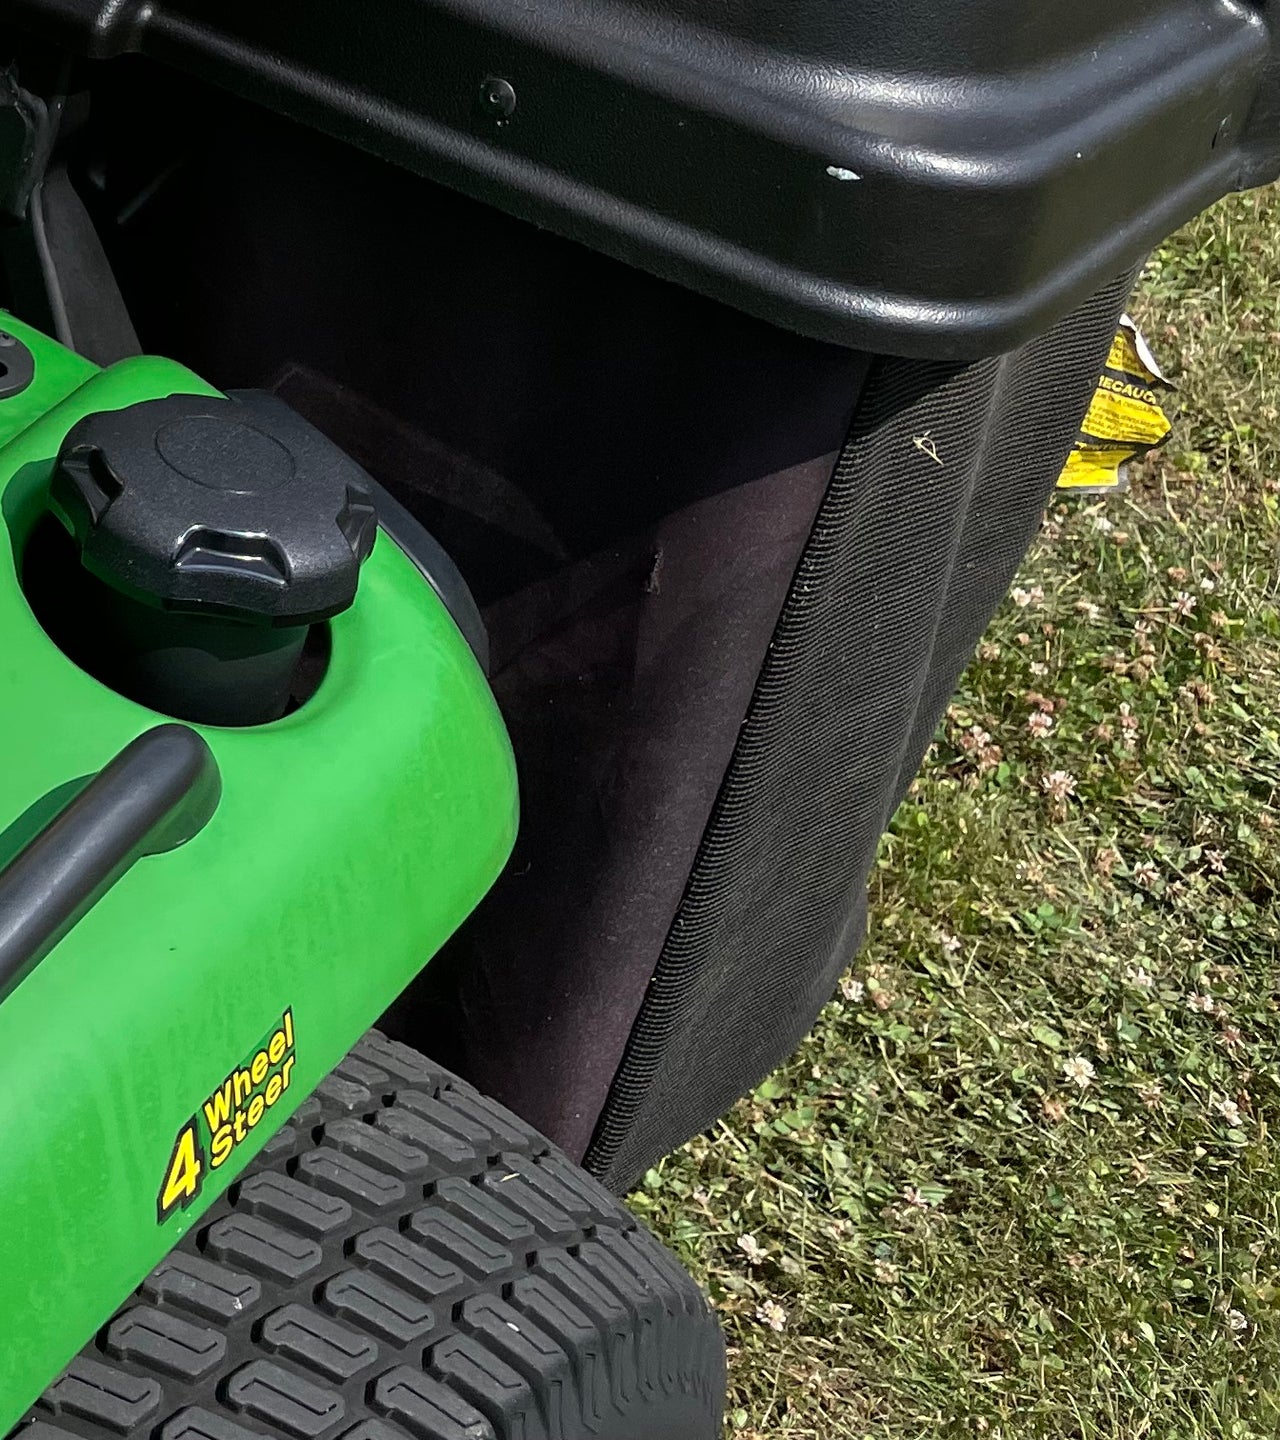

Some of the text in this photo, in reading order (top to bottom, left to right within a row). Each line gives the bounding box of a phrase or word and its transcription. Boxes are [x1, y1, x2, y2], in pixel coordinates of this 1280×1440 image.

[203, 1009, 295, 1134] Wheel
[209, 1054, 296, 1169] Steer
[160, 1122, 203, 1214] 4
